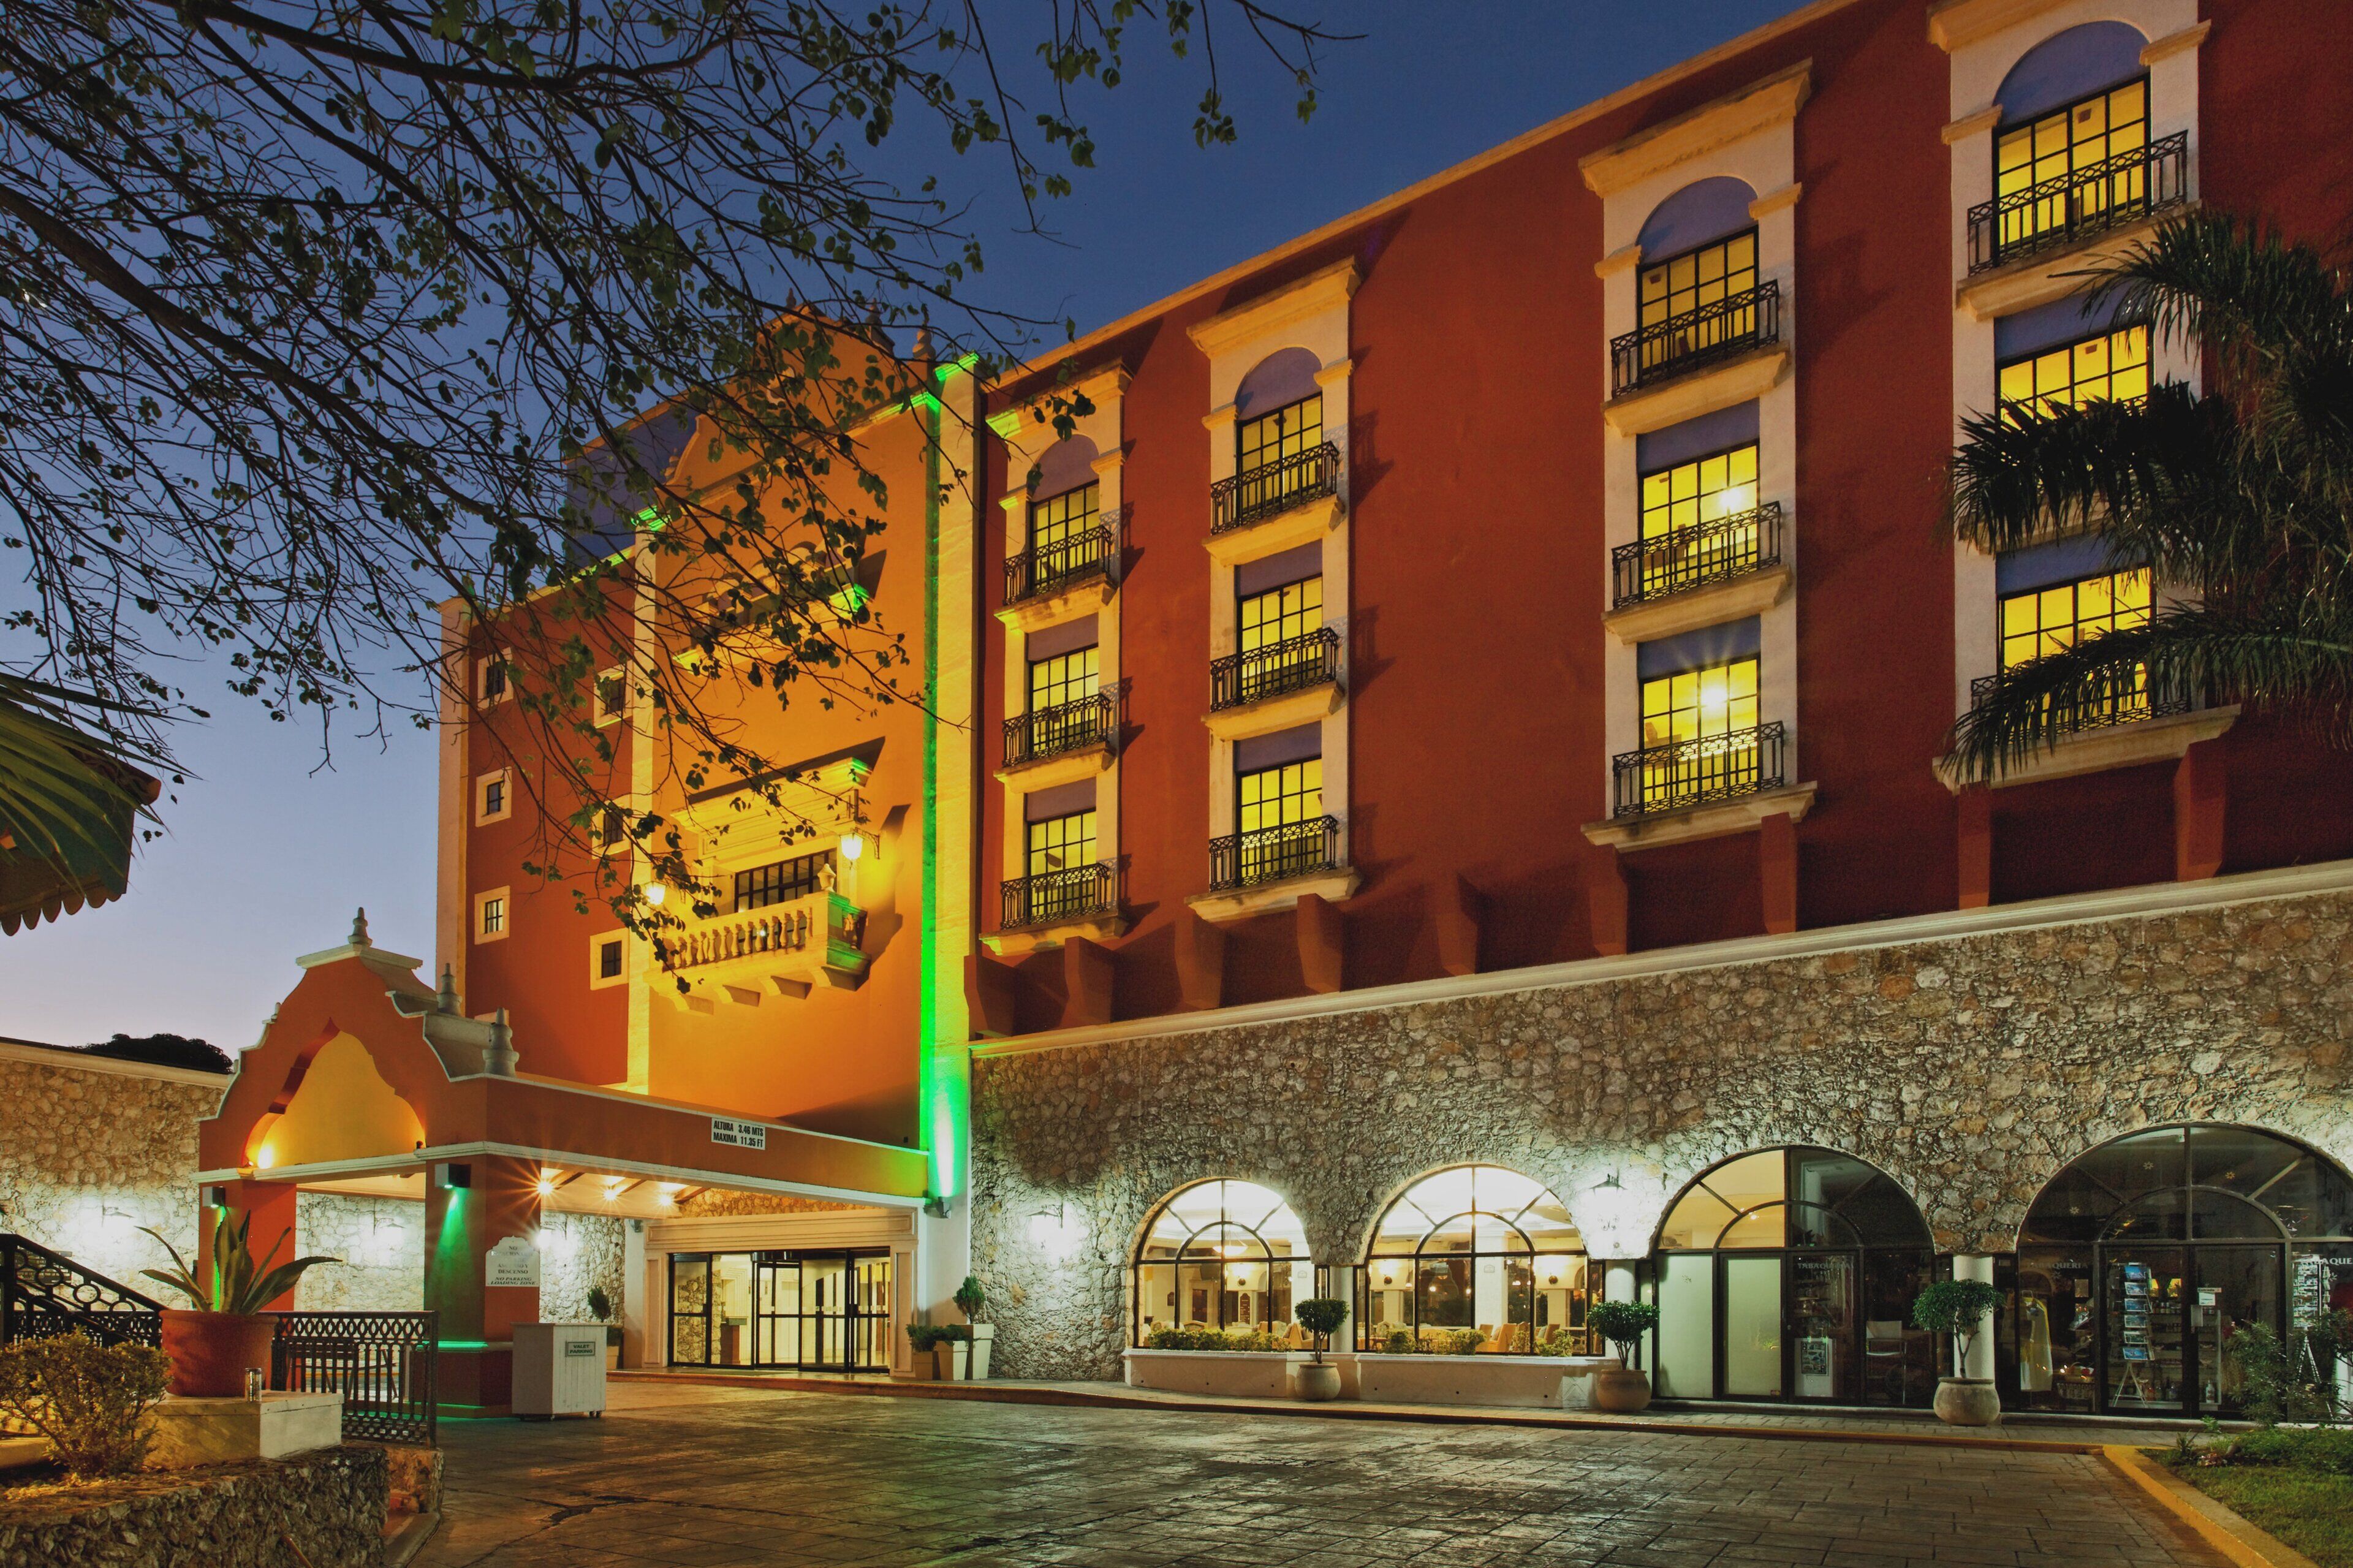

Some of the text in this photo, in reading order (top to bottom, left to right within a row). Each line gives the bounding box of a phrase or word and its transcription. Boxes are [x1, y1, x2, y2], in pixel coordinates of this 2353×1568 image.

[713, 1120, 763, 1137] ALTURA 3.46 MTS
[713, 1132, 763, 1148] MAXIMA 11.35 FT
